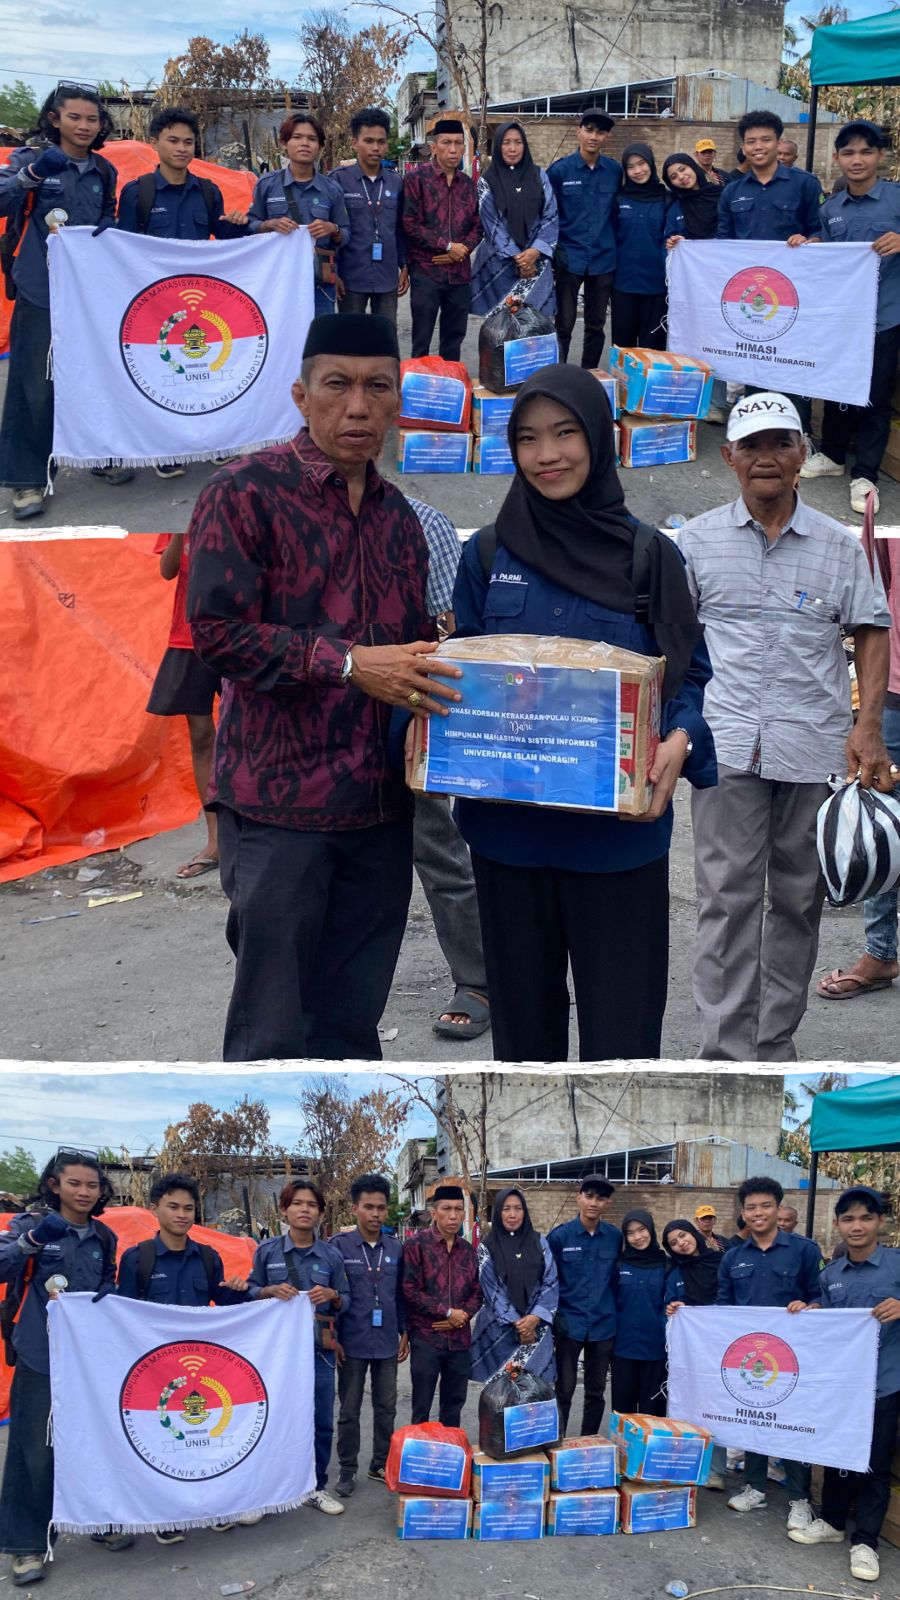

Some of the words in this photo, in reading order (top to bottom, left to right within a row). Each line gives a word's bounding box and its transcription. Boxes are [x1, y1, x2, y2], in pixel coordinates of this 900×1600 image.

[124, 296, 149, 341] HIMPUNAN
[148, 280, 200, 298] MAHASISWA
[203, 280, 235, 297] SISTEM
[235, 294, 264, 332] INFORMASI
[702, 346, 748, 359] UNIVERSITAS
[749, 353, 773, 362] ISLAM
[774, 357, 816, 368] INDRAGIRI
[736, 342, 777, 355] HIMASI
[125, 352, 157, 398] FAKULTAS
[159, 395, 196, 411] TEKNIK
[211, 391, 236, 409] ILMU
[238, 342, 265, 392] KOMPUTER
[185, 373, 210, 382] UNISI
[737, 401, 788, 418] NAVY
[499, 573, 522, 581] PARMI
[472, 709, 500, 718] KORBAN
[571, 715, 598, 724] KIJANG
[444, 730, 482, 739] HIMPUNAN
[483, 733, 527, 743] MAHASISWA
[527, 737, 555, 745] SISTEM
[556, 738, 598, 748] INFORMASI
[463, 748, 512, 759] UNIVERSITAS
[513, 752, 538, 761] ISLAM
[539, 754, 578, 765] INDRAGIRI
[124, 1363, 149, 1407] HIMPUNAN
[148, 1345, 200, 1364] MAHASISWA
[204, 1346, 235, 1363] SISTEM
[235, 1360, 264, 1399] INFORMASI
[702, 1412, 748, 1425] UNIVERSITAS
[749, 1419, 772, 1429] ISLAM
[774, 1423, 816, 1434] INDRAGIRI
[736, 1408, 777, 1421] HIMASI
[126, 1417, 157, 1463] FAKULTAS
[159, 1461, 196, 1478] TEKNIK
[200, 1469, 207, 1477] &
[211, 1457, 236, 1474] ILMU
[238, 1408, 265, 1458] KOMPUTER
[185, 1439, 210, 1448] UNISI
